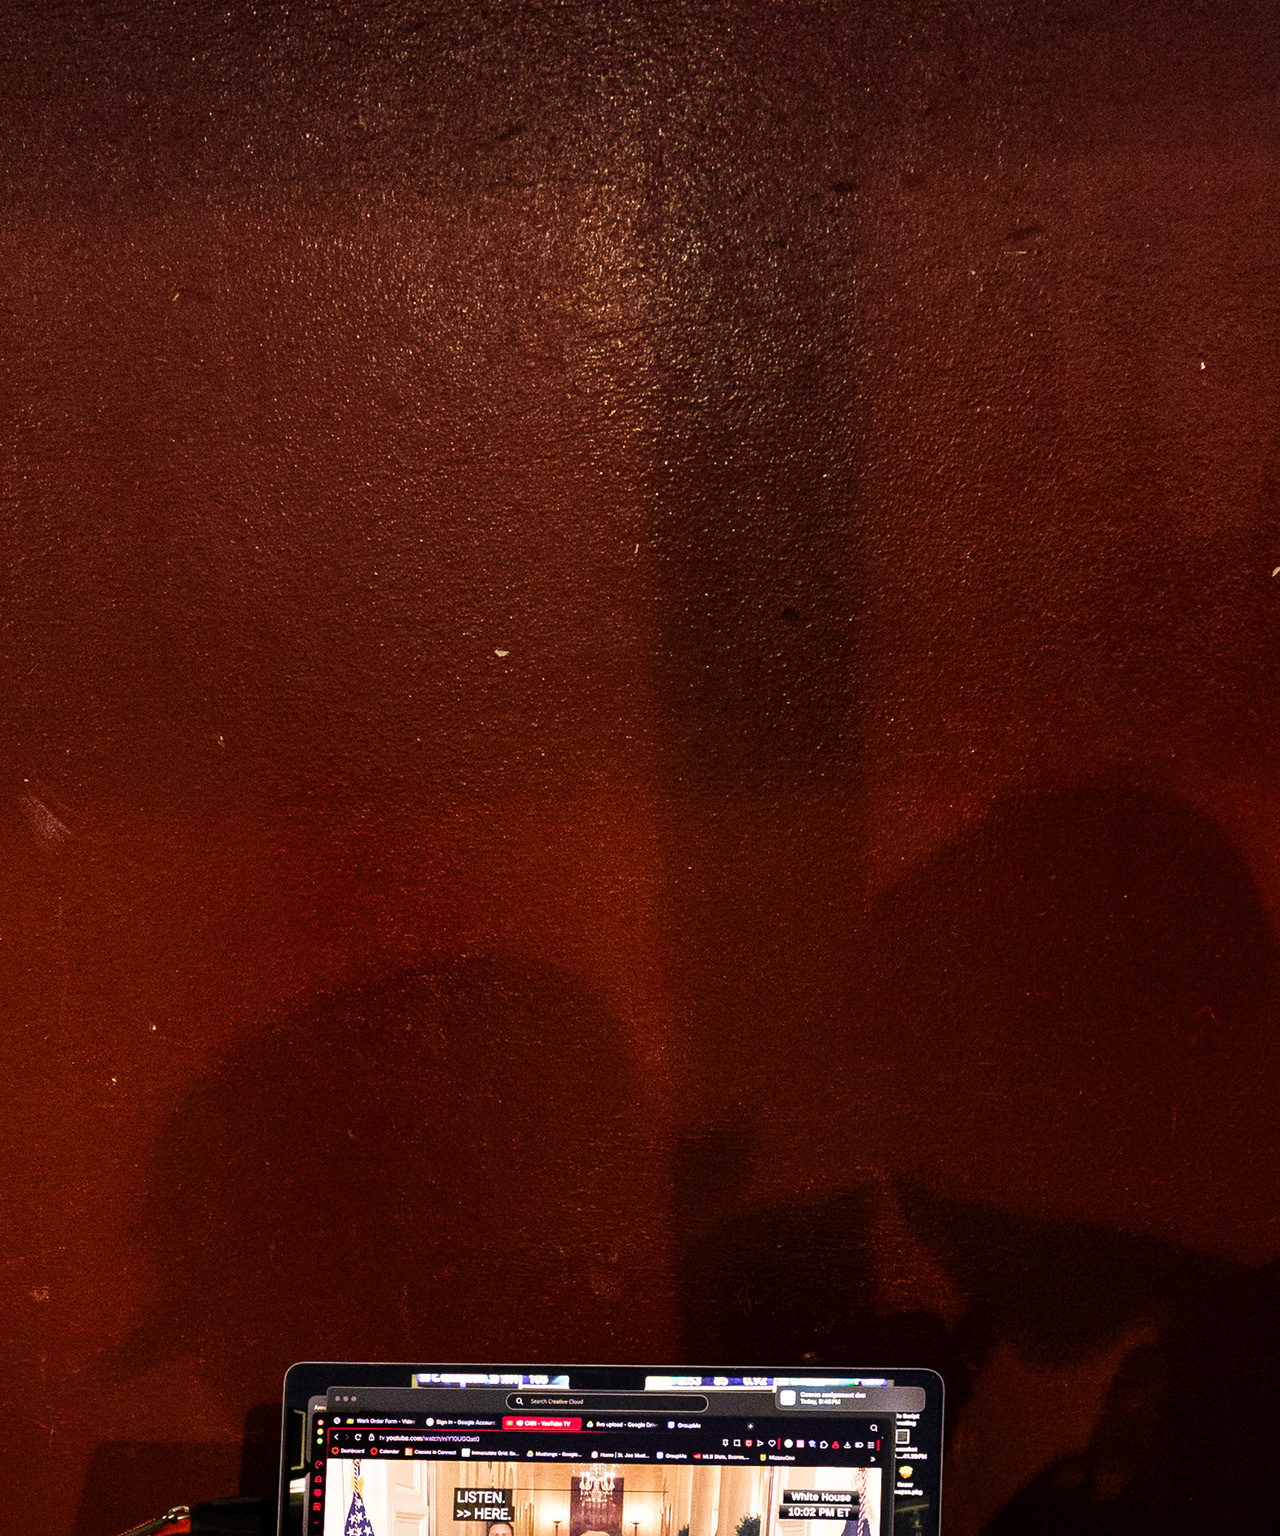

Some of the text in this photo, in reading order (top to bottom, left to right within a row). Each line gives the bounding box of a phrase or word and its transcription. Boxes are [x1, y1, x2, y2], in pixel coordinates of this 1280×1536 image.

[457, 1490, 506, 1505] LISTEN.
[791, 1491, 851, 1504] White House
[474, 1508, 512, 1521] HERE.
[787, 1507, 851, 1518] 10:02 PM ET
